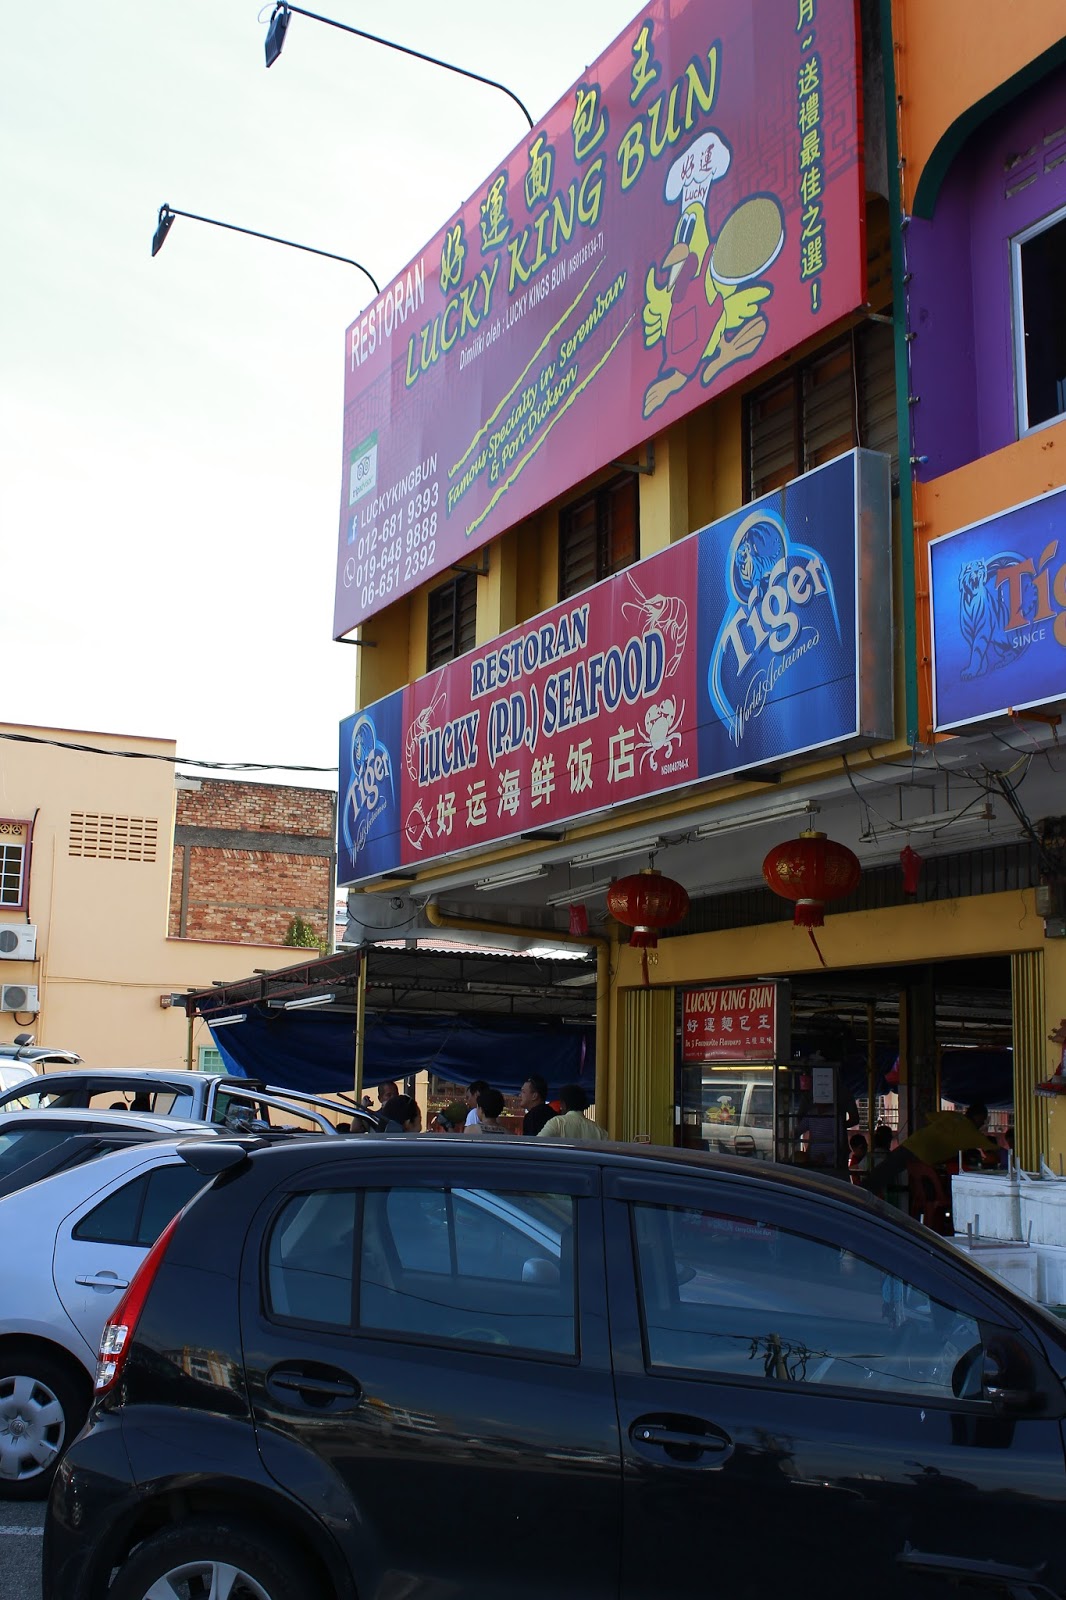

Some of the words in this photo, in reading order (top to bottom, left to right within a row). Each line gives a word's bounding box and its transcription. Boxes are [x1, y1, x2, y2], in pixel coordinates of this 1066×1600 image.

[681, 143, 715, 180] 好運
[685, 184, 708, 202] Lucky
[405, 258, 498, 386] LUCKY
[508, 158, 603, 292] KING
[617, 46, 717, 190] BUN
[351, 258, 425, 372] RESTORAN
[459, 336, 485, 371] Dimiliki
[486, 319, 501, 347] oleh
[506, 293, 528, 329] LUCKY
[528, 276, 550, 310] KINGS
[551, 259, 566, 290] BUN
[448, 448, 488, 513] Famous
[488, 384, 538, 457] Specialty
[540, 362, 556, 392] in
[559, 272, 627, 368] Seremban
[490, 459, 499, 481] &
[501, 423, 527, 469] Port
[528, 365, 578, 436] Dickson
[358, 508, 403, 560] 012-681
[408, 482, 439, 523] 9393
[361, 452, 438, 529] LUCKYKINGBUN
[356, 537, 402, 588] 019-648
[406, 511, 438, 553] 9888
[361, 564, 400, 609] 06-651
[404, 540, 436, 582] 2392
[471, 603, 590, 700] RESTORAN
[722, 557, 828, 676] Tiger
[1012, 628, 1047, 650] SINCE
[418, 709, 481, 787] LUCKY
[542, 629, 667, 737] SEAFOOD
[729, 668, 767, 747] World
[763, 626, 820, 692] Acclaimed
[350, 749, 391, 822] Tiger
[436, 725, 636, 838] 好运海鲜饭店
[685, 991, 719, 1014] LUCKY
[720, 988, 747, 1012] KING
[748, 986, 773, 1013] BUN
